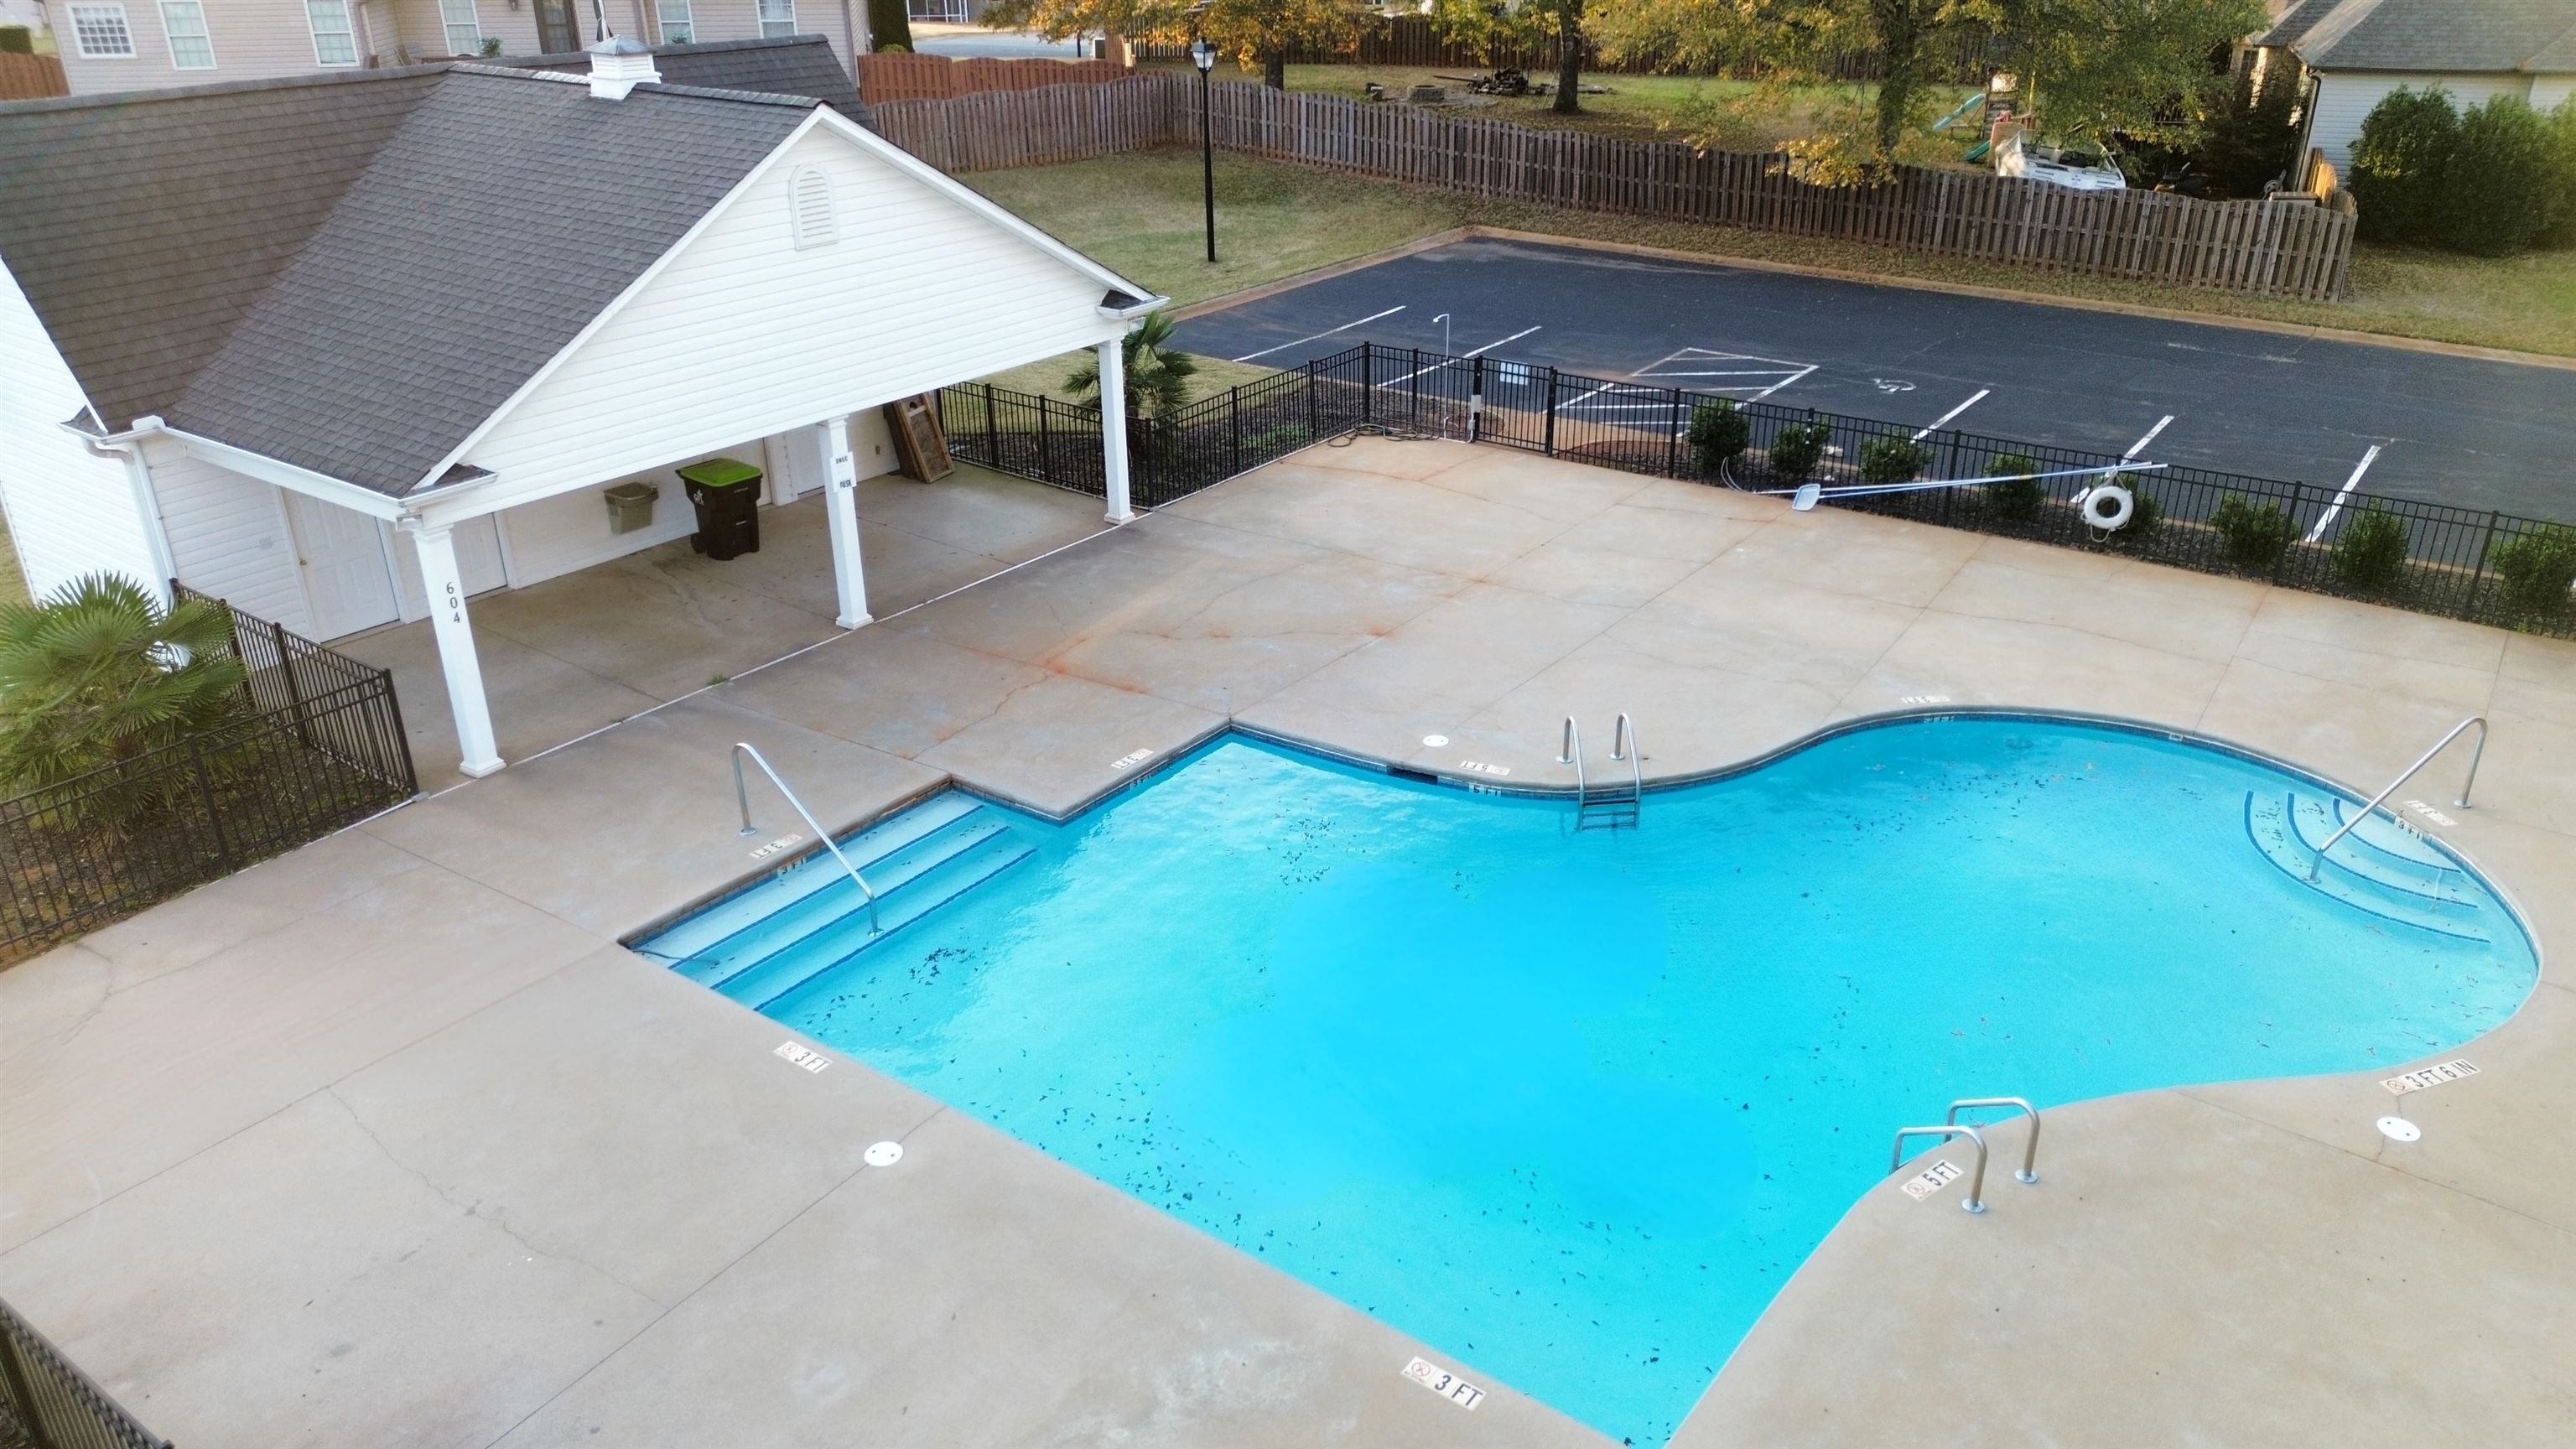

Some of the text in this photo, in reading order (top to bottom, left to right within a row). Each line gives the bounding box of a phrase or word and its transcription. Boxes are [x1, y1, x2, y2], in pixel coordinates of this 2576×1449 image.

[446, 581, 460, 623] 604
[794, 1052, 831, 1072] 3 FT
[2405, 1060, 2479, 1088] 3 FT 6 IN
[1921, 1161, 1959, 1187] 5 FT
[1434, 1374, 1452, 1391] 3
[1451, 1383, 1483, 1406] FT
